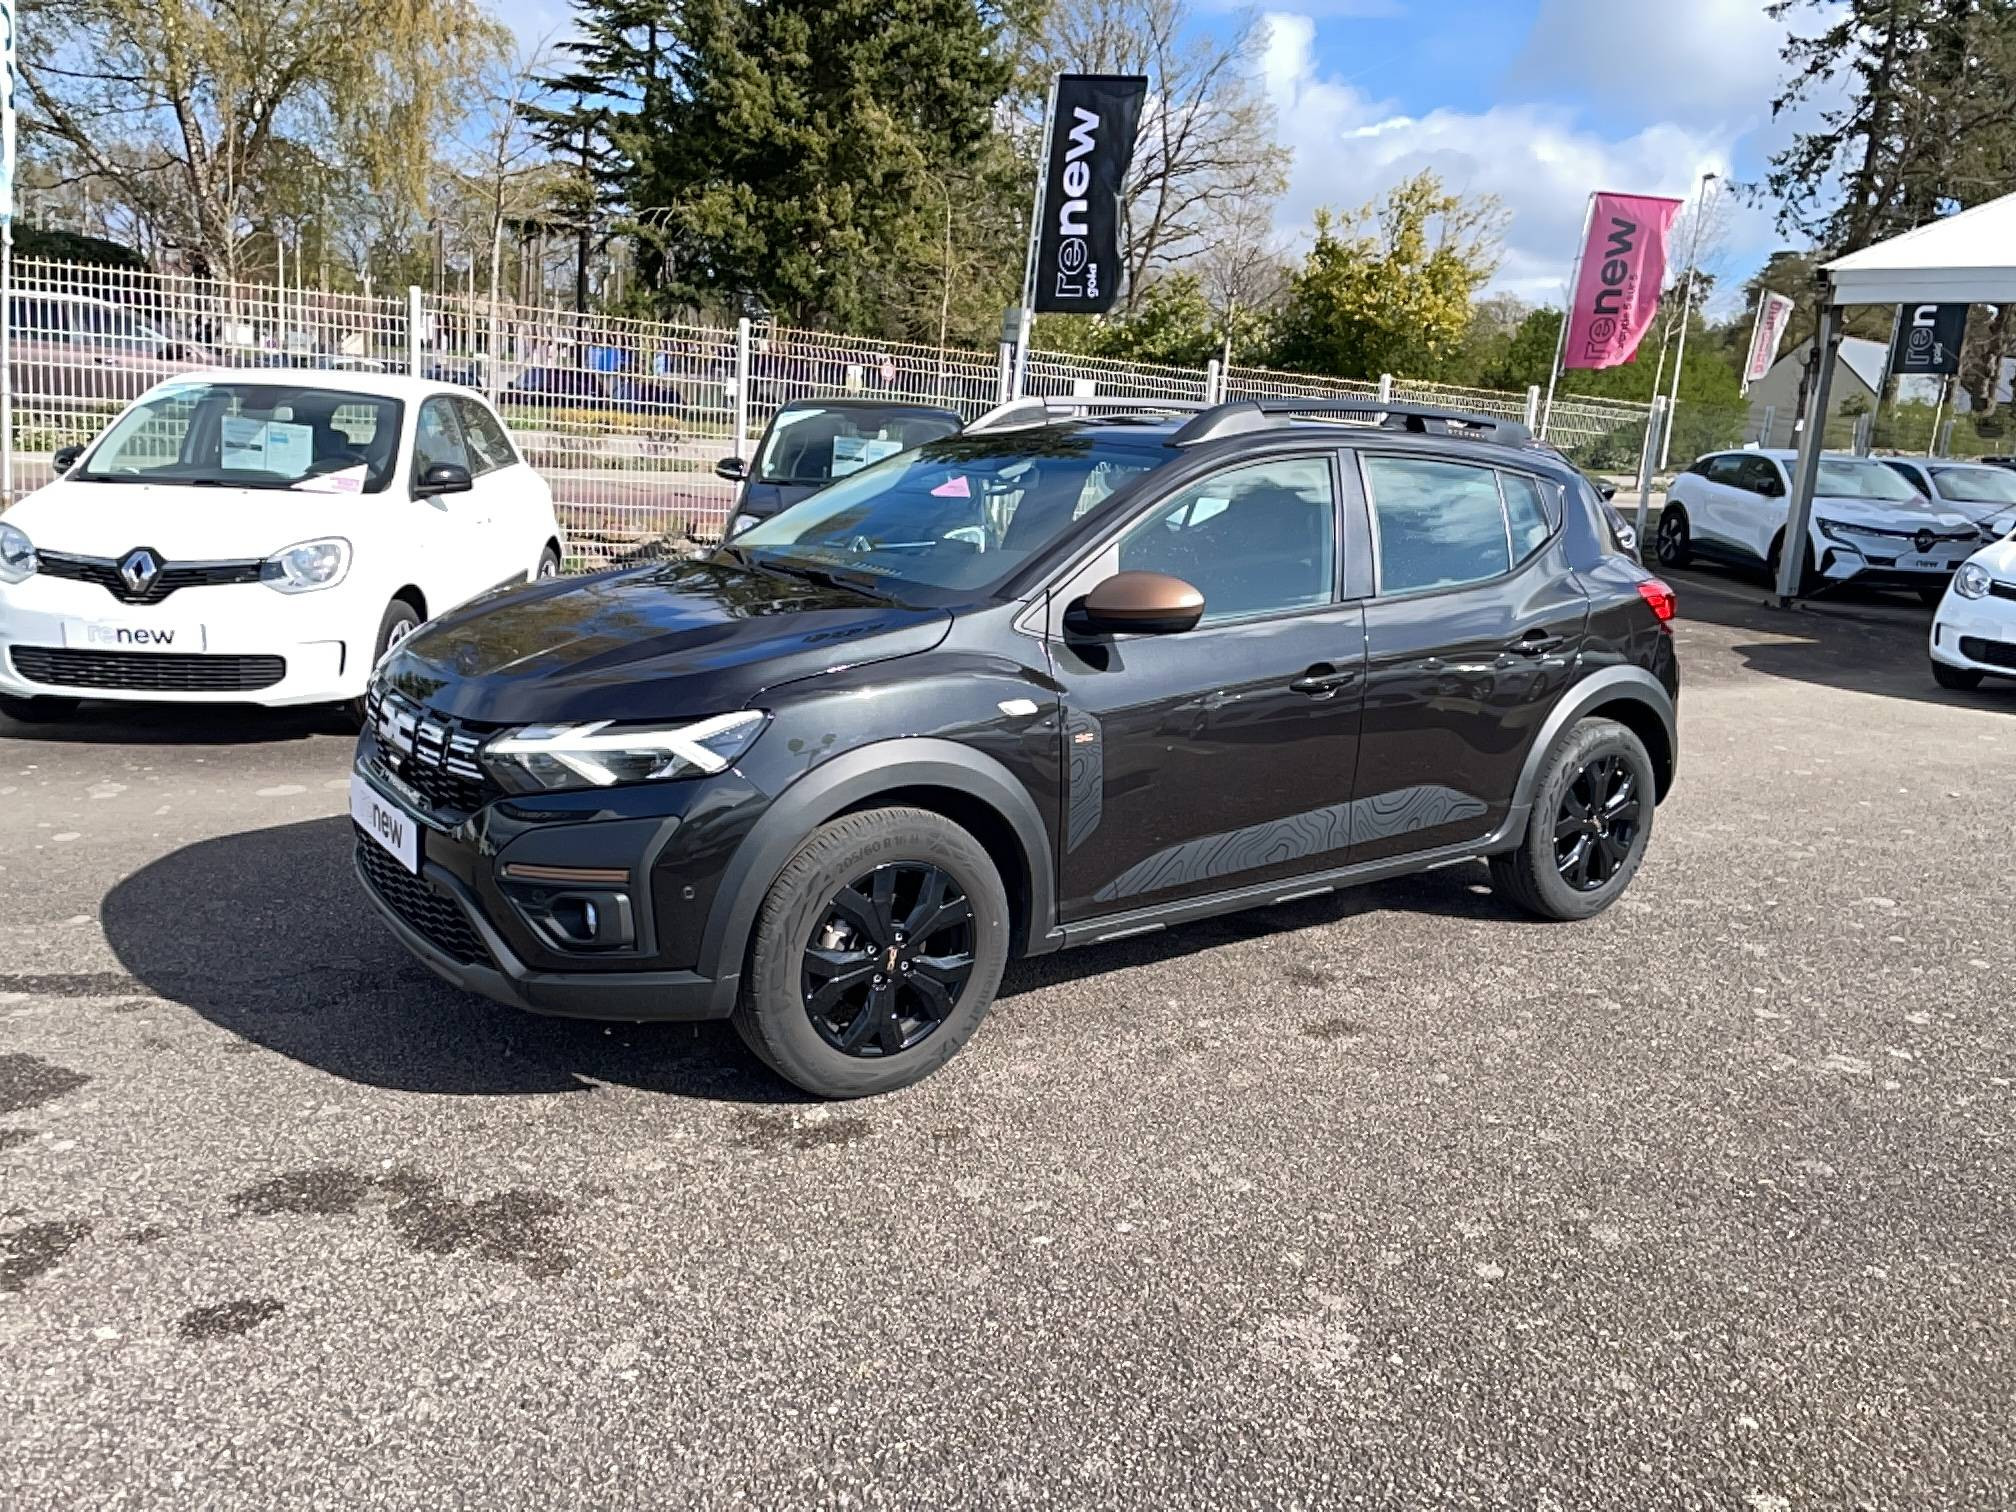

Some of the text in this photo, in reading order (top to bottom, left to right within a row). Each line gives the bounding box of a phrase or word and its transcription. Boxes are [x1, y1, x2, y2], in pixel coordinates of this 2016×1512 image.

[1055, 106, 1100, 298] renew
[1087, 263, 1099, 298] gold
[1584, 217, 1636, 360] renew
[1905, 305, 1938, 365] ren
[87, 625, 175, 644] renew
